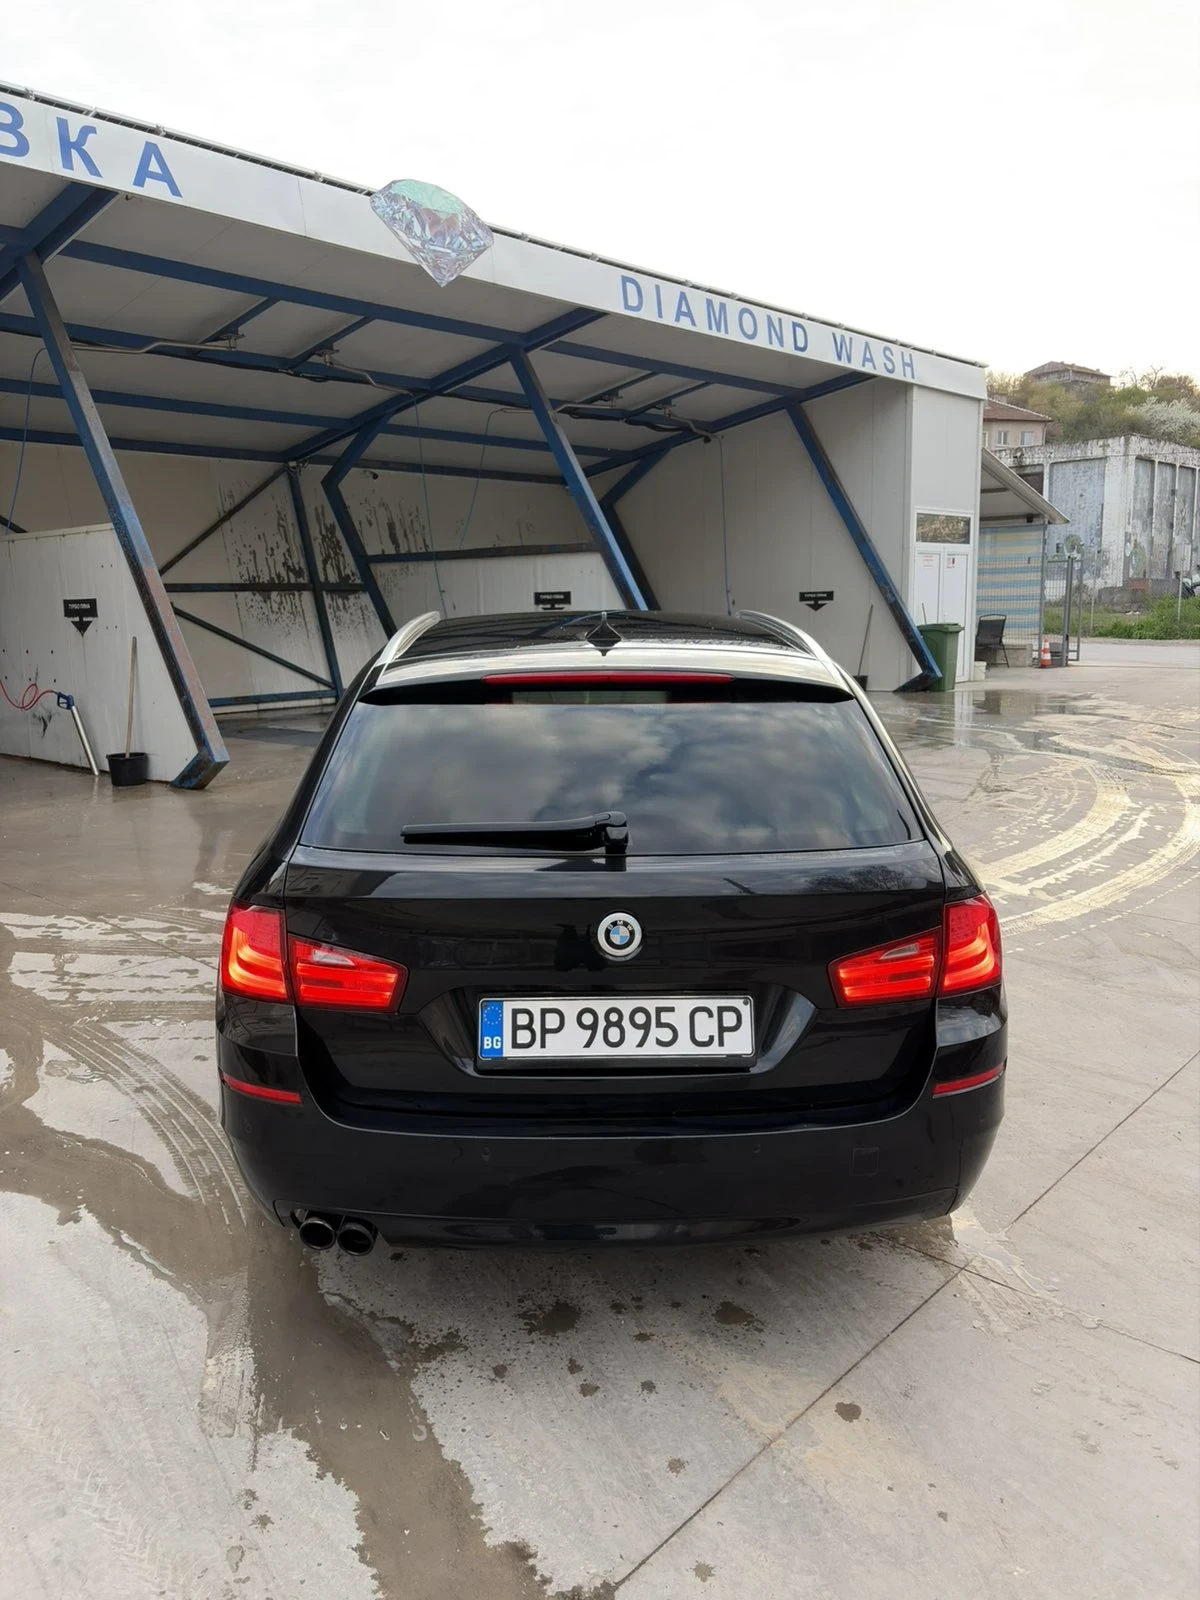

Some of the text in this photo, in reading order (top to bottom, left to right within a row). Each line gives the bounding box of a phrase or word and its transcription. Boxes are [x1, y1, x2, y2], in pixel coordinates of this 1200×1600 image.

[620, 275, 916, 379] DIAMOND WASH
[483, 1036, 502, 1050] BG
[511, 1006, 743, 1049] BP 9895 CP
